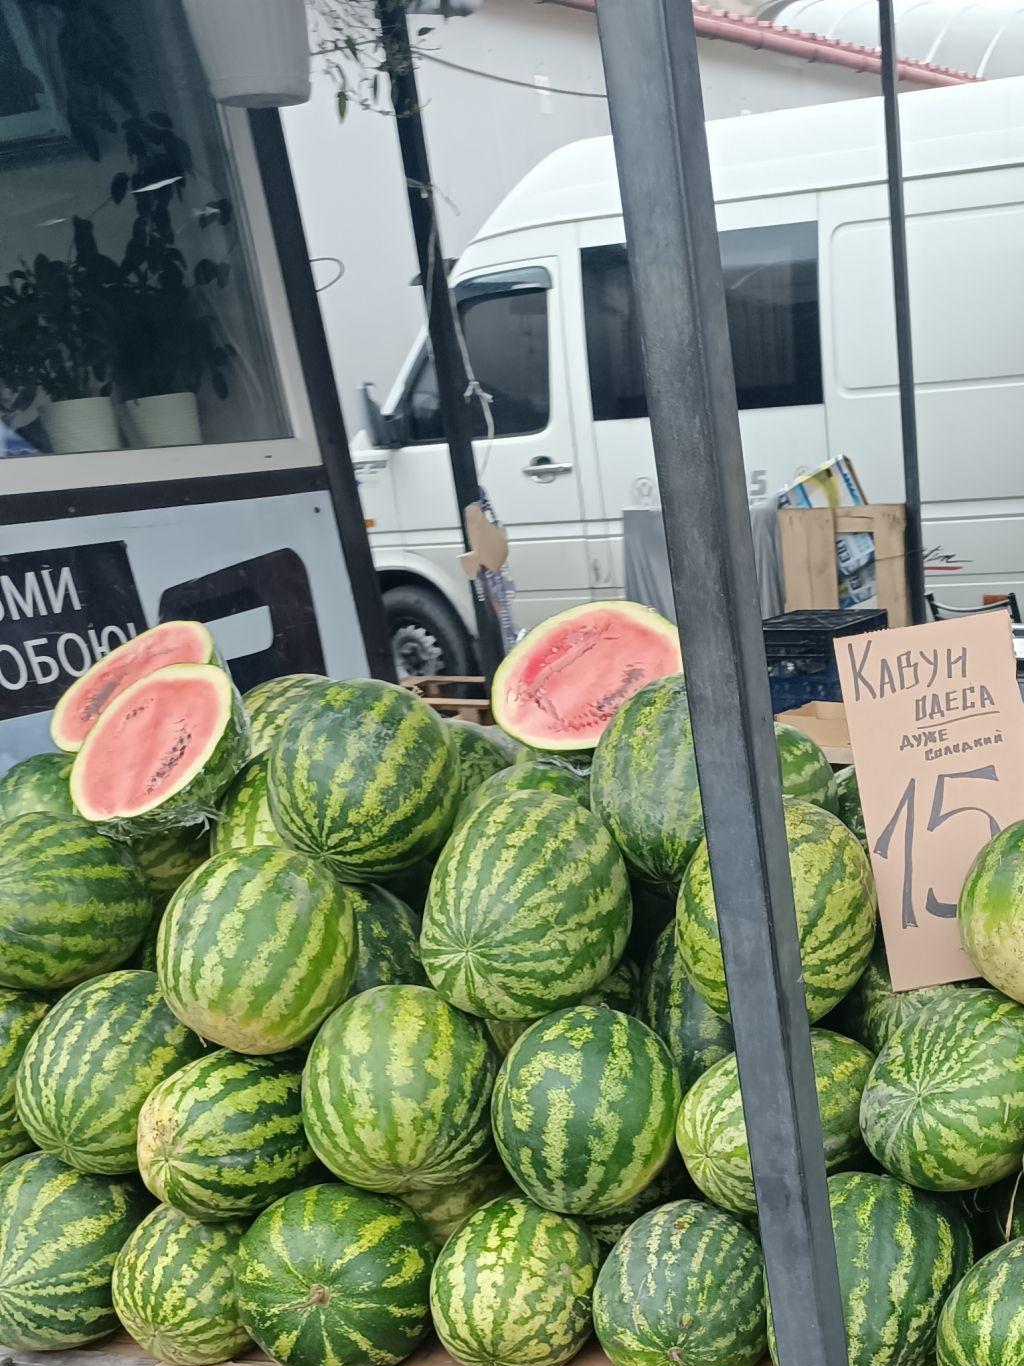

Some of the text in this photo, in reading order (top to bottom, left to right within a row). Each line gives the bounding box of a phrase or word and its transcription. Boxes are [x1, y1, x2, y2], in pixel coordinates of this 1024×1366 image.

[0, 566, 82, 622] МИ
[848, 640, 967, 702] КАВУН
[915, 685, 995, 721] ОДЕСА
[900, 729, 949, 751] ДУЖЕ
[873, 765, 1000, 929] 15
